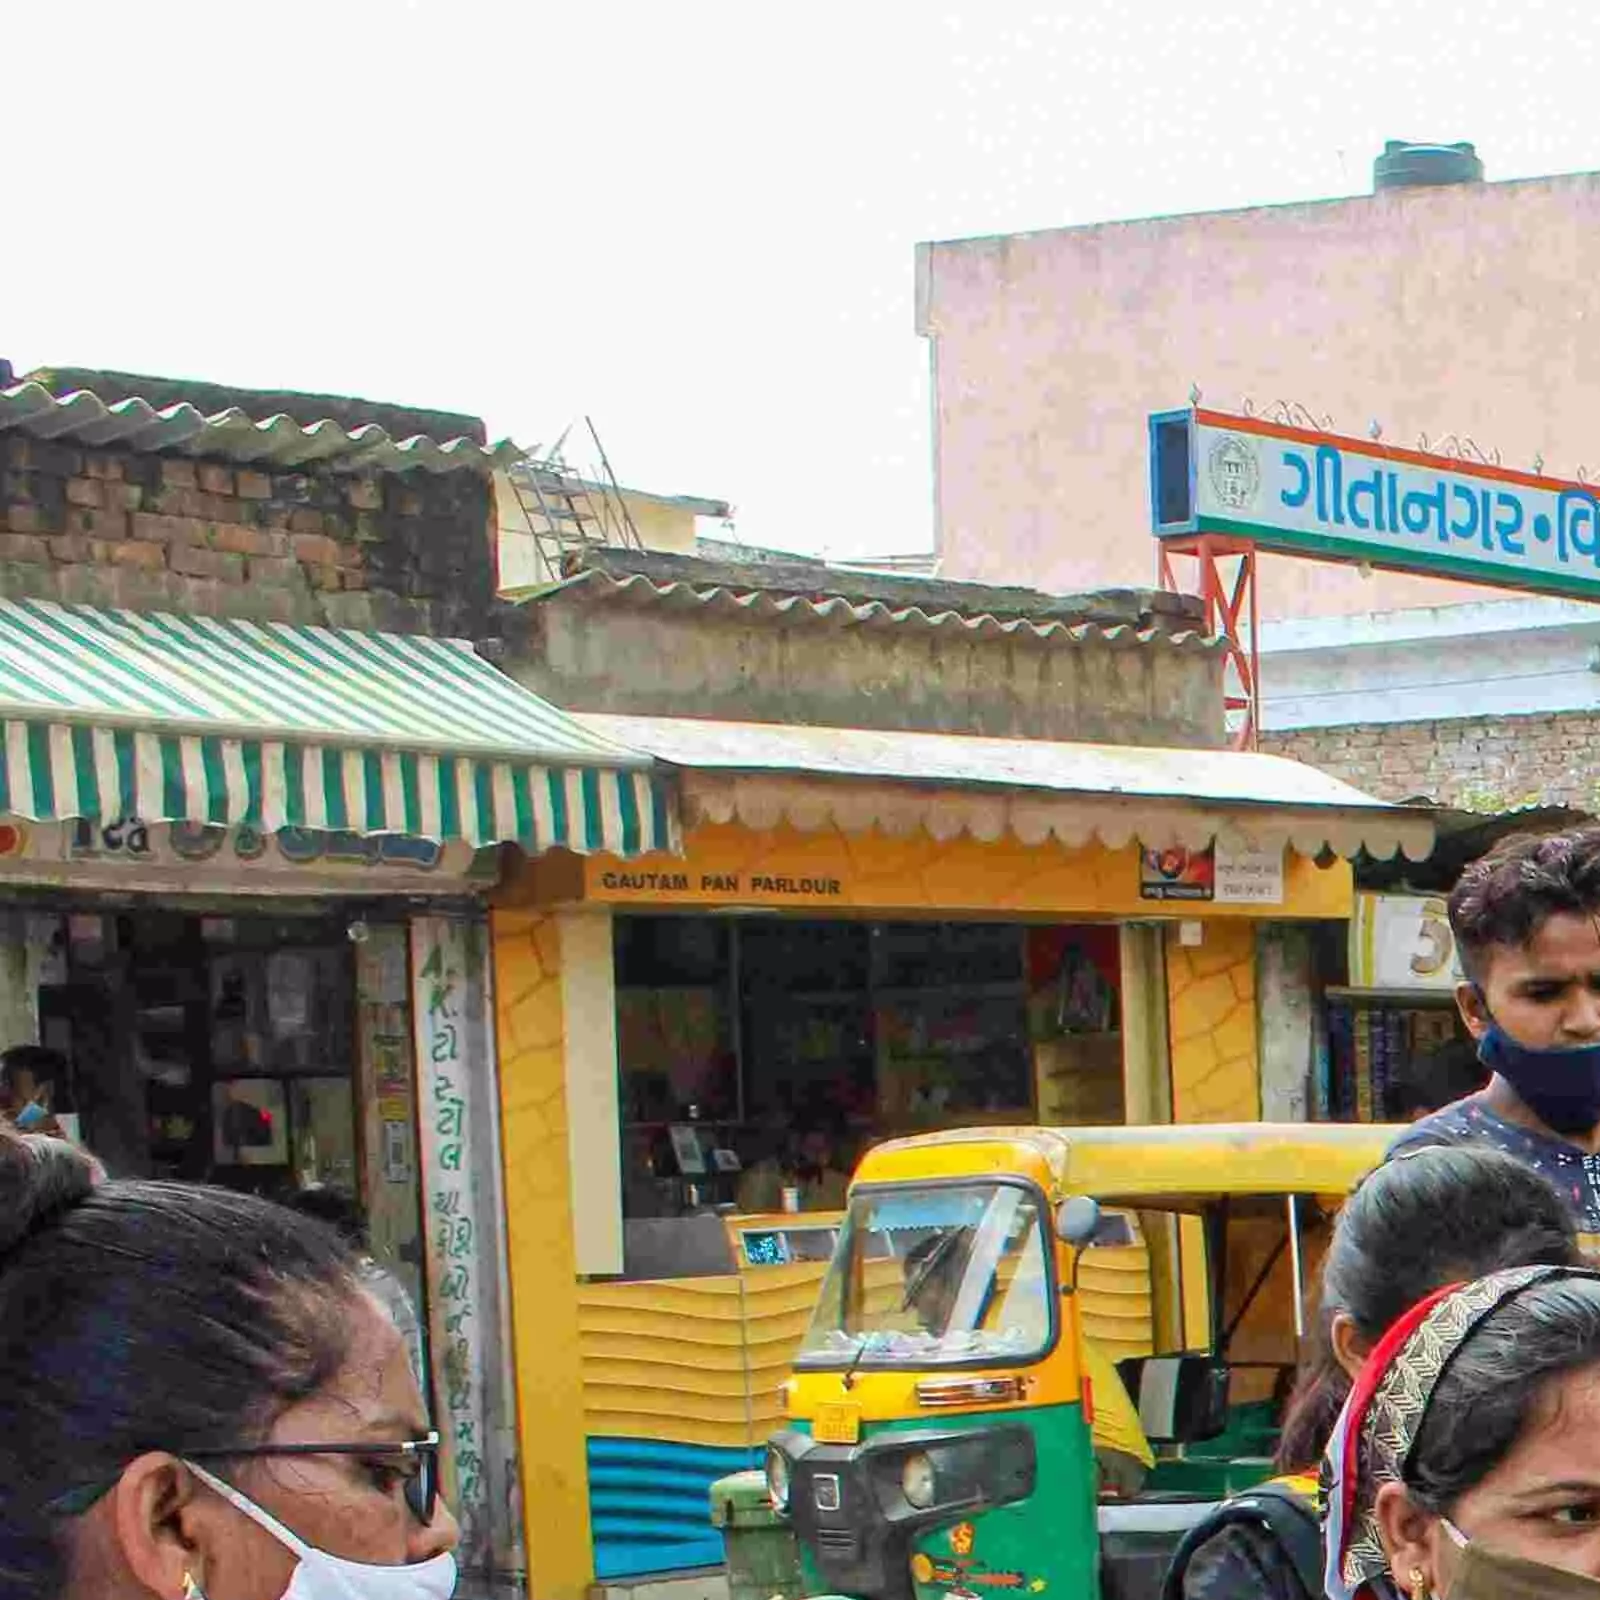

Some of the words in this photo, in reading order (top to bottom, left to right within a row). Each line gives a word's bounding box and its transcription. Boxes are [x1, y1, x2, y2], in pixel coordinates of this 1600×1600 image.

[1280, 443, 1526, 556] ગીતાનગર
[602, 872, 689, 891] GAUTAM
[700, 874, 739, 892] PAN
[751, 876, 841, 895] PARLOUR
